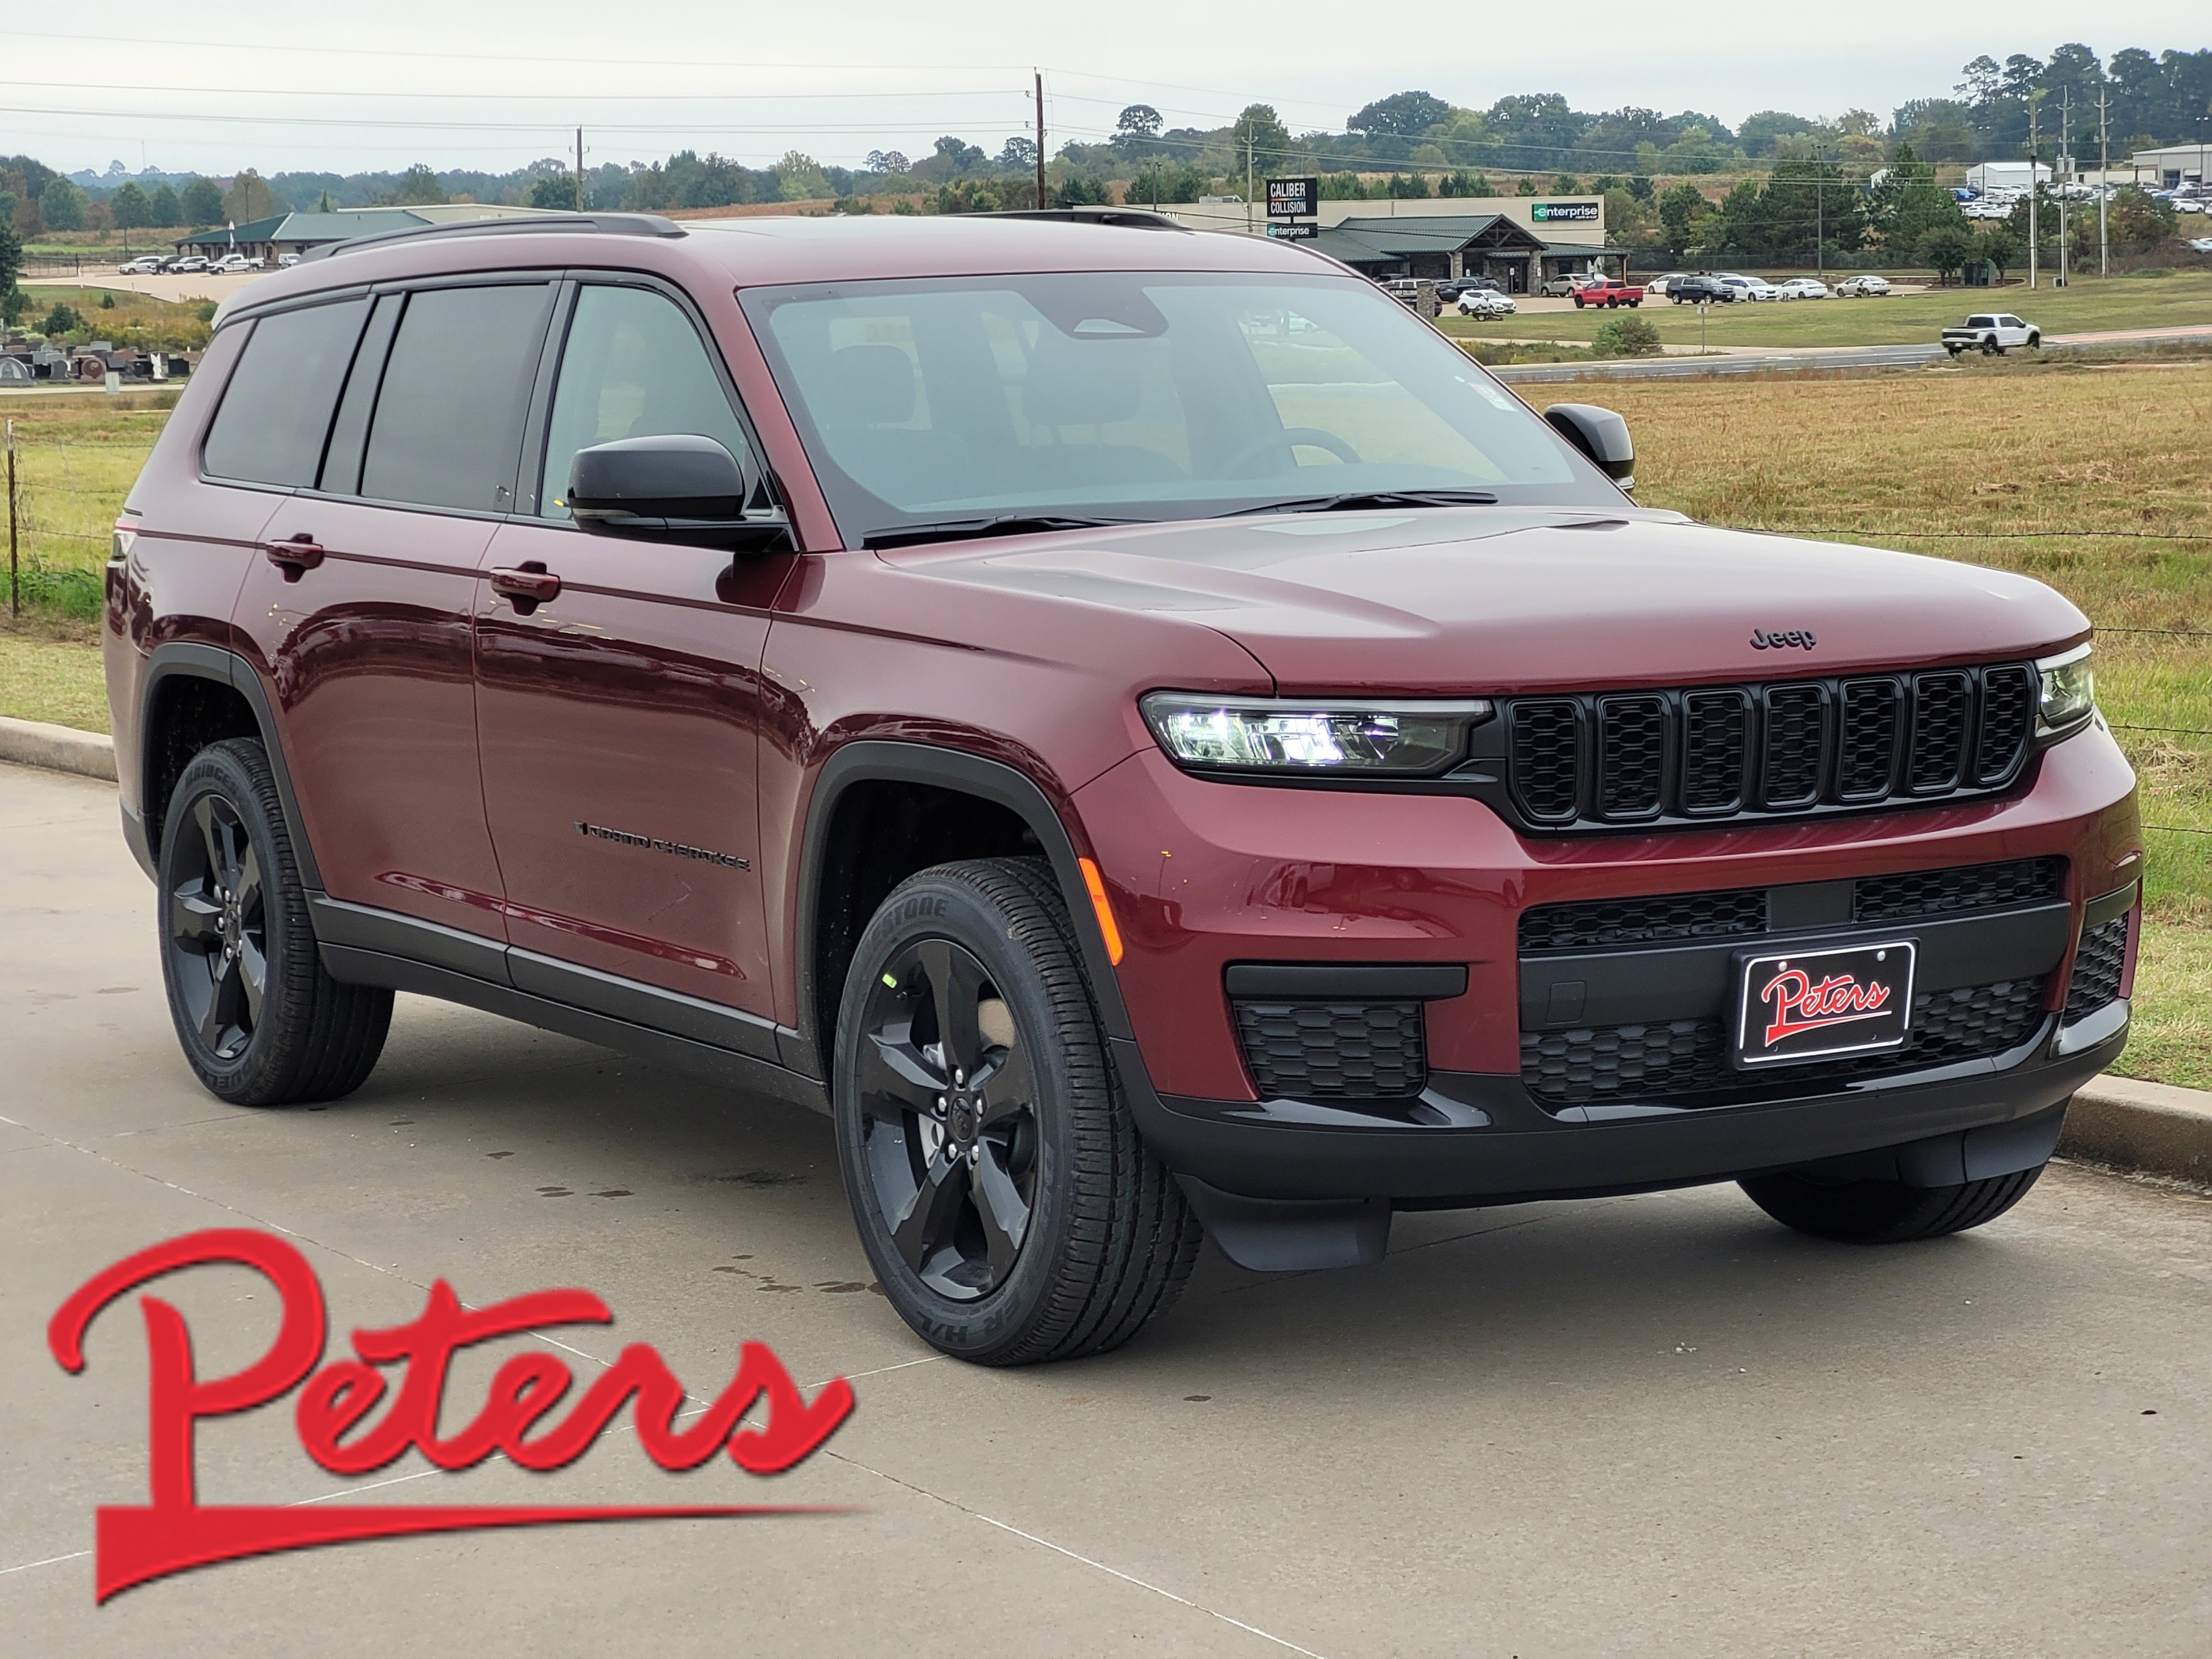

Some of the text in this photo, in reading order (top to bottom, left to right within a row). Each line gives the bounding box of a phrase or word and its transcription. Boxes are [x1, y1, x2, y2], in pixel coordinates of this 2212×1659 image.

[1270, 182, 1306, 197] CALIBER
[1271, 201, 1306, 214] COLLISION
[1534, 205, 1598, 218] enterprise
[1268, 225, 1310, 237] enterprise
[1750, 628, 1816, 651] Jeep
[1761, 969, 1892, 1047] Peters
